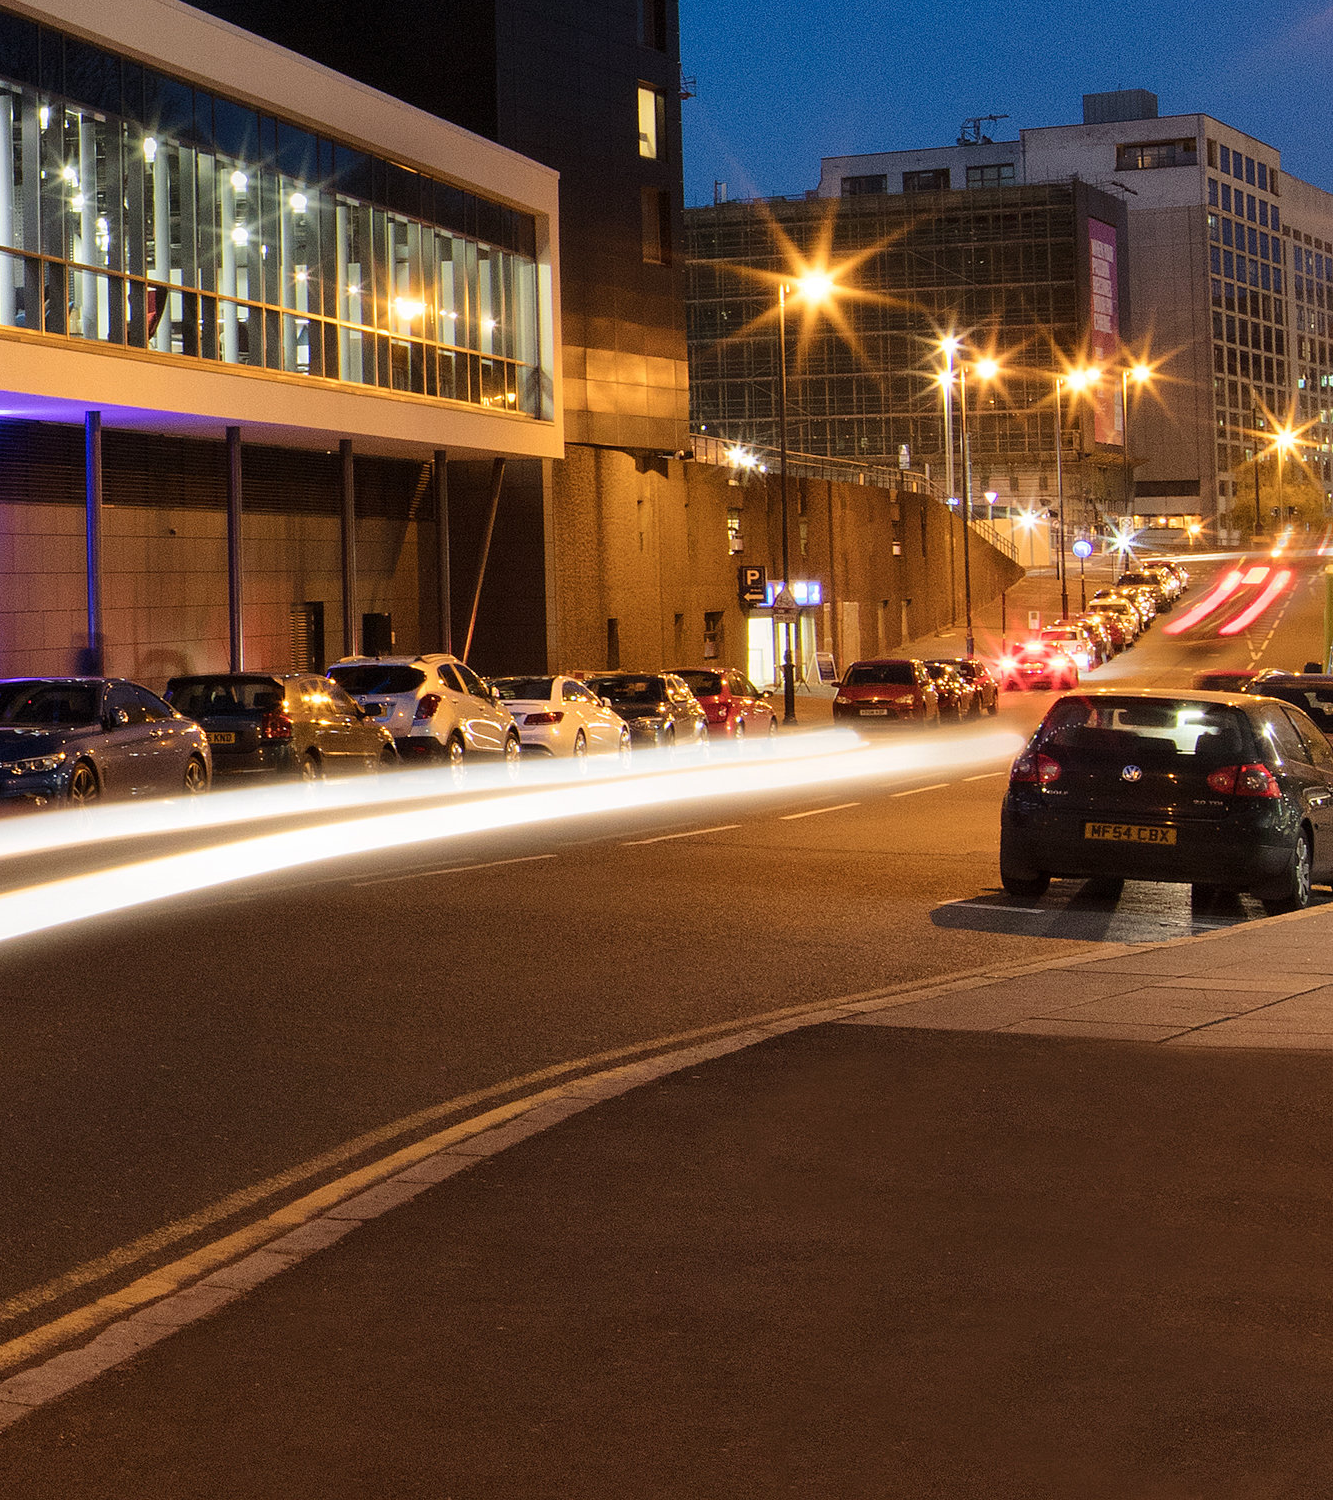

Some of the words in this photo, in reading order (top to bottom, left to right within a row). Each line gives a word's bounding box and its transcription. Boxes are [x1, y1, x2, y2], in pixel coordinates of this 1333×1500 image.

[746, 569, 760, 586] P
[1091, 824, 1132, 840] MF54
[1137, 827, 1170, 842] CBX
